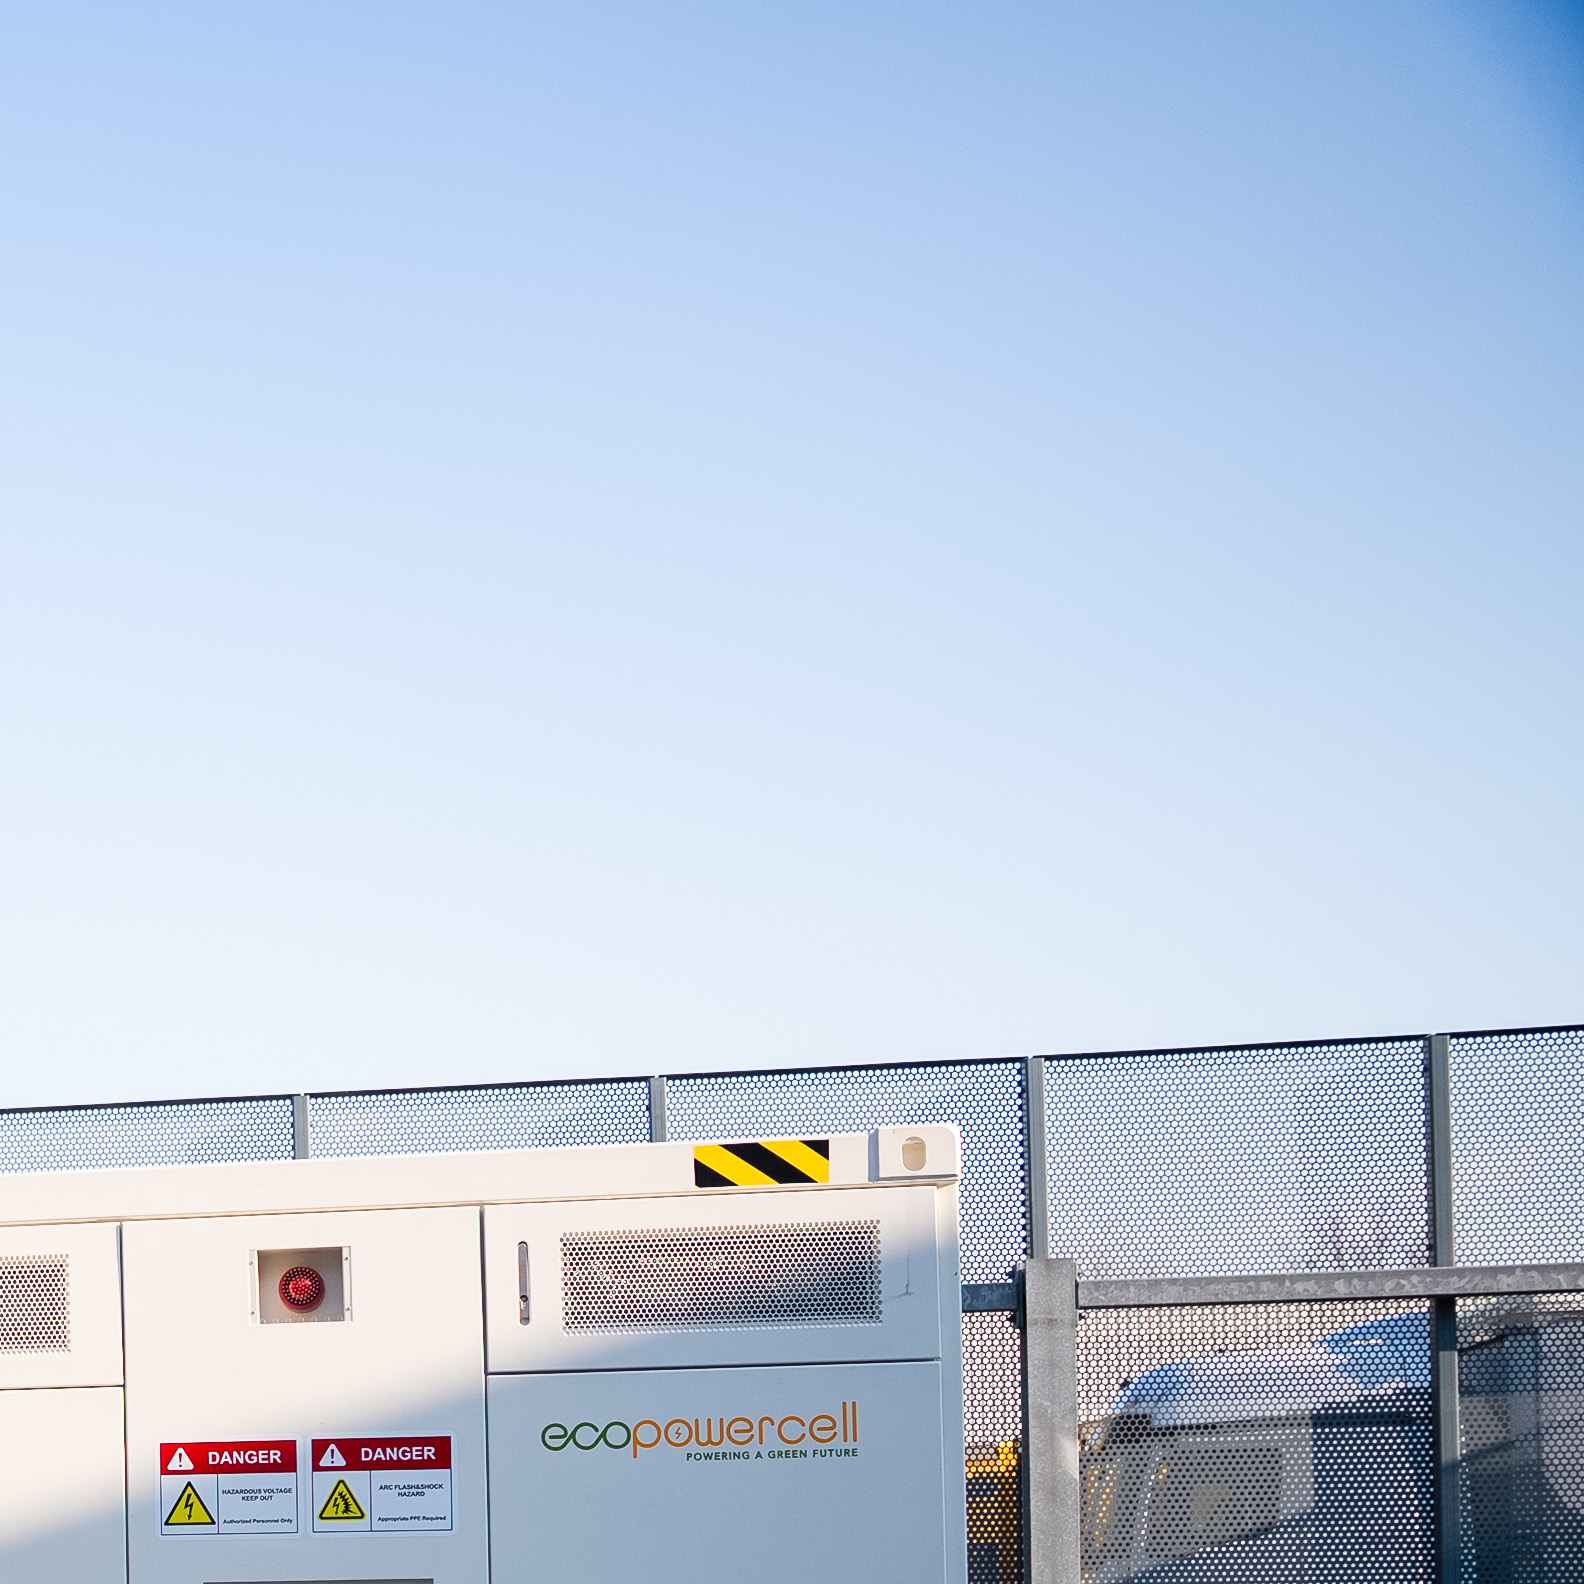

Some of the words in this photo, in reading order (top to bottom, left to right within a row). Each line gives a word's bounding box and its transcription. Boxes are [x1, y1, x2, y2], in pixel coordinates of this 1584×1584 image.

[540, 1401, 859, 1459] ecopowercell
[208, 1449, 282, 1465] DANGER
[360, 1446, 436, 1462] DANGER
[686, 1451, 750, 1462] POWERING
[755, 1451, 764, 1460] A
[768, 1449, 808, 1460] GREEN
[812, 1448, 858, 1458] FUTURE
